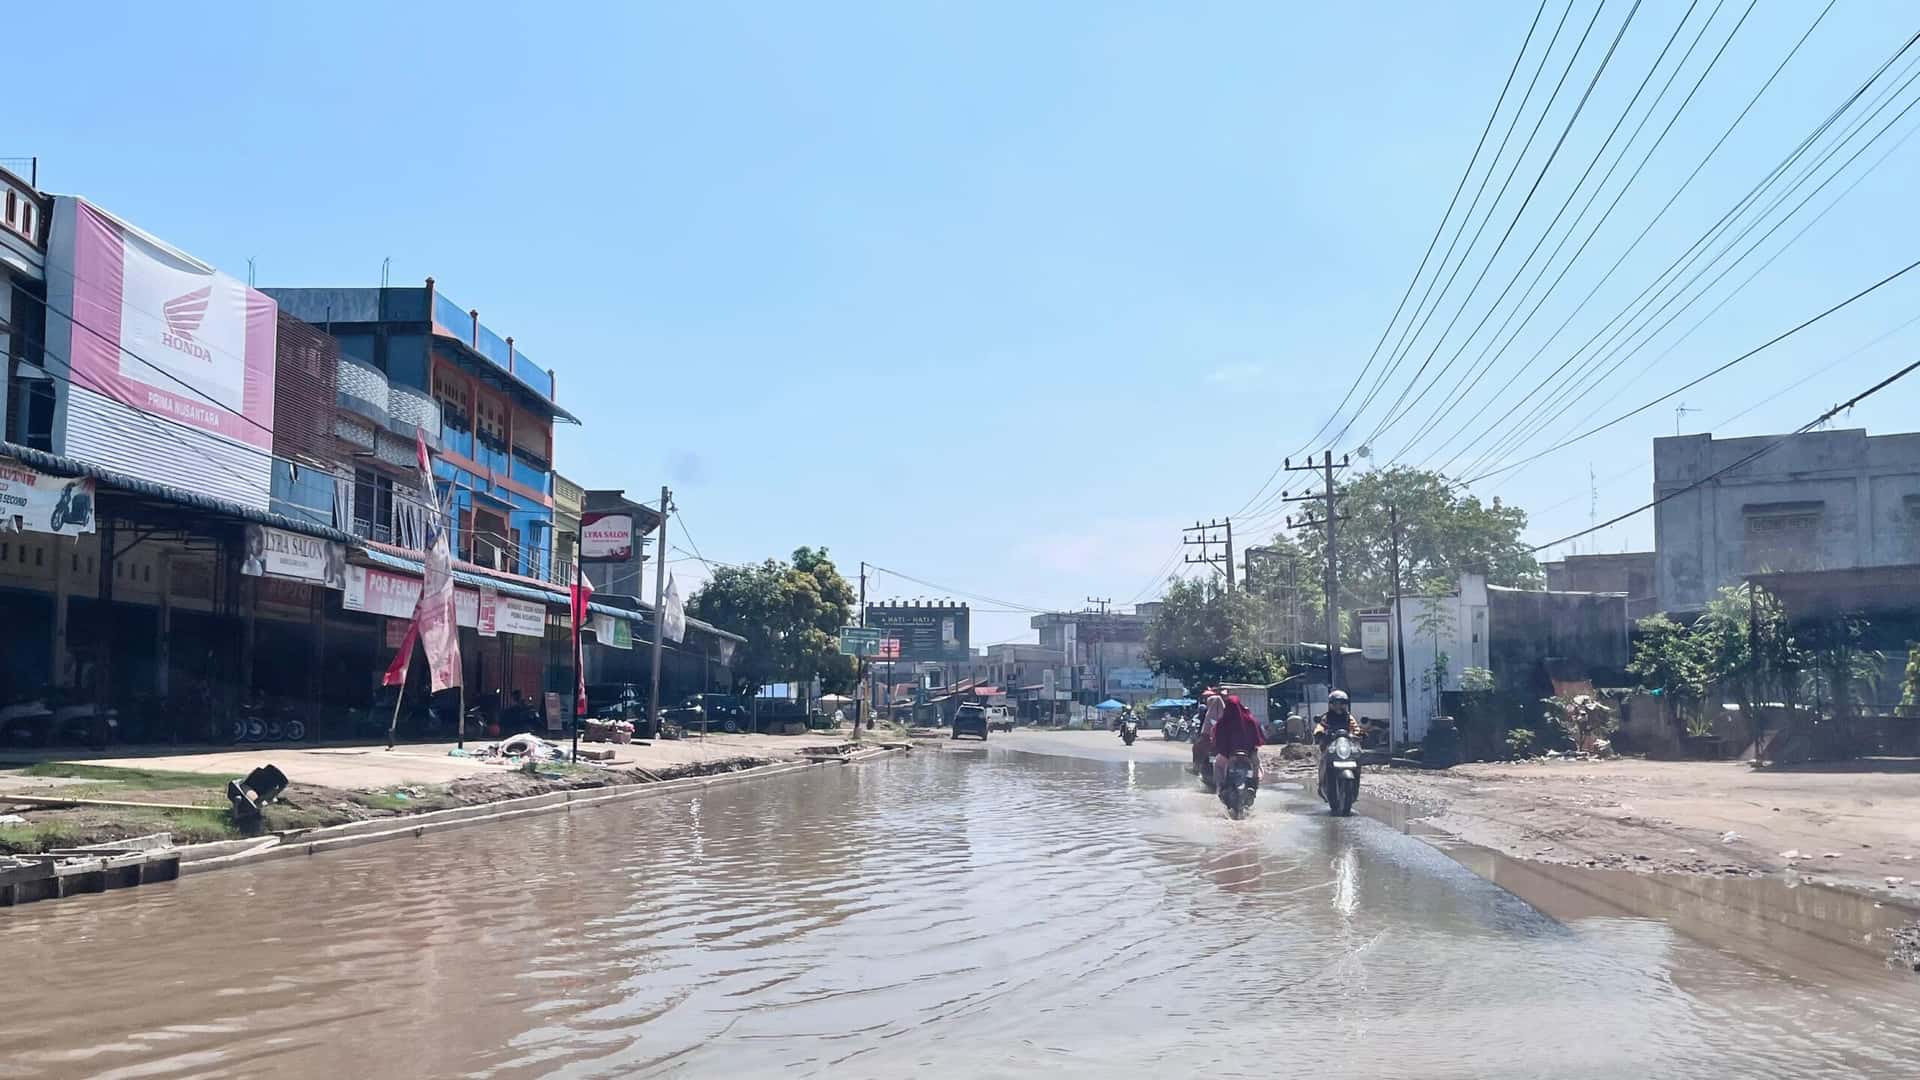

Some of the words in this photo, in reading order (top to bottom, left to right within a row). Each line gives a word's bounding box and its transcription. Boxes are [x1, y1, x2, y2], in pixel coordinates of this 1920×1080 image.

[162, 333, 212, 362] HONDA
[148, 392, 174, 411] PRIMA
[175, 401, 219, 425] NUSANTARA
[3, 493, 27, 507] SECOND
[584, 530, 602, 538] LYRA
[604, 530, 629, 538] SALON
[368, 573, 389, 592] POS
